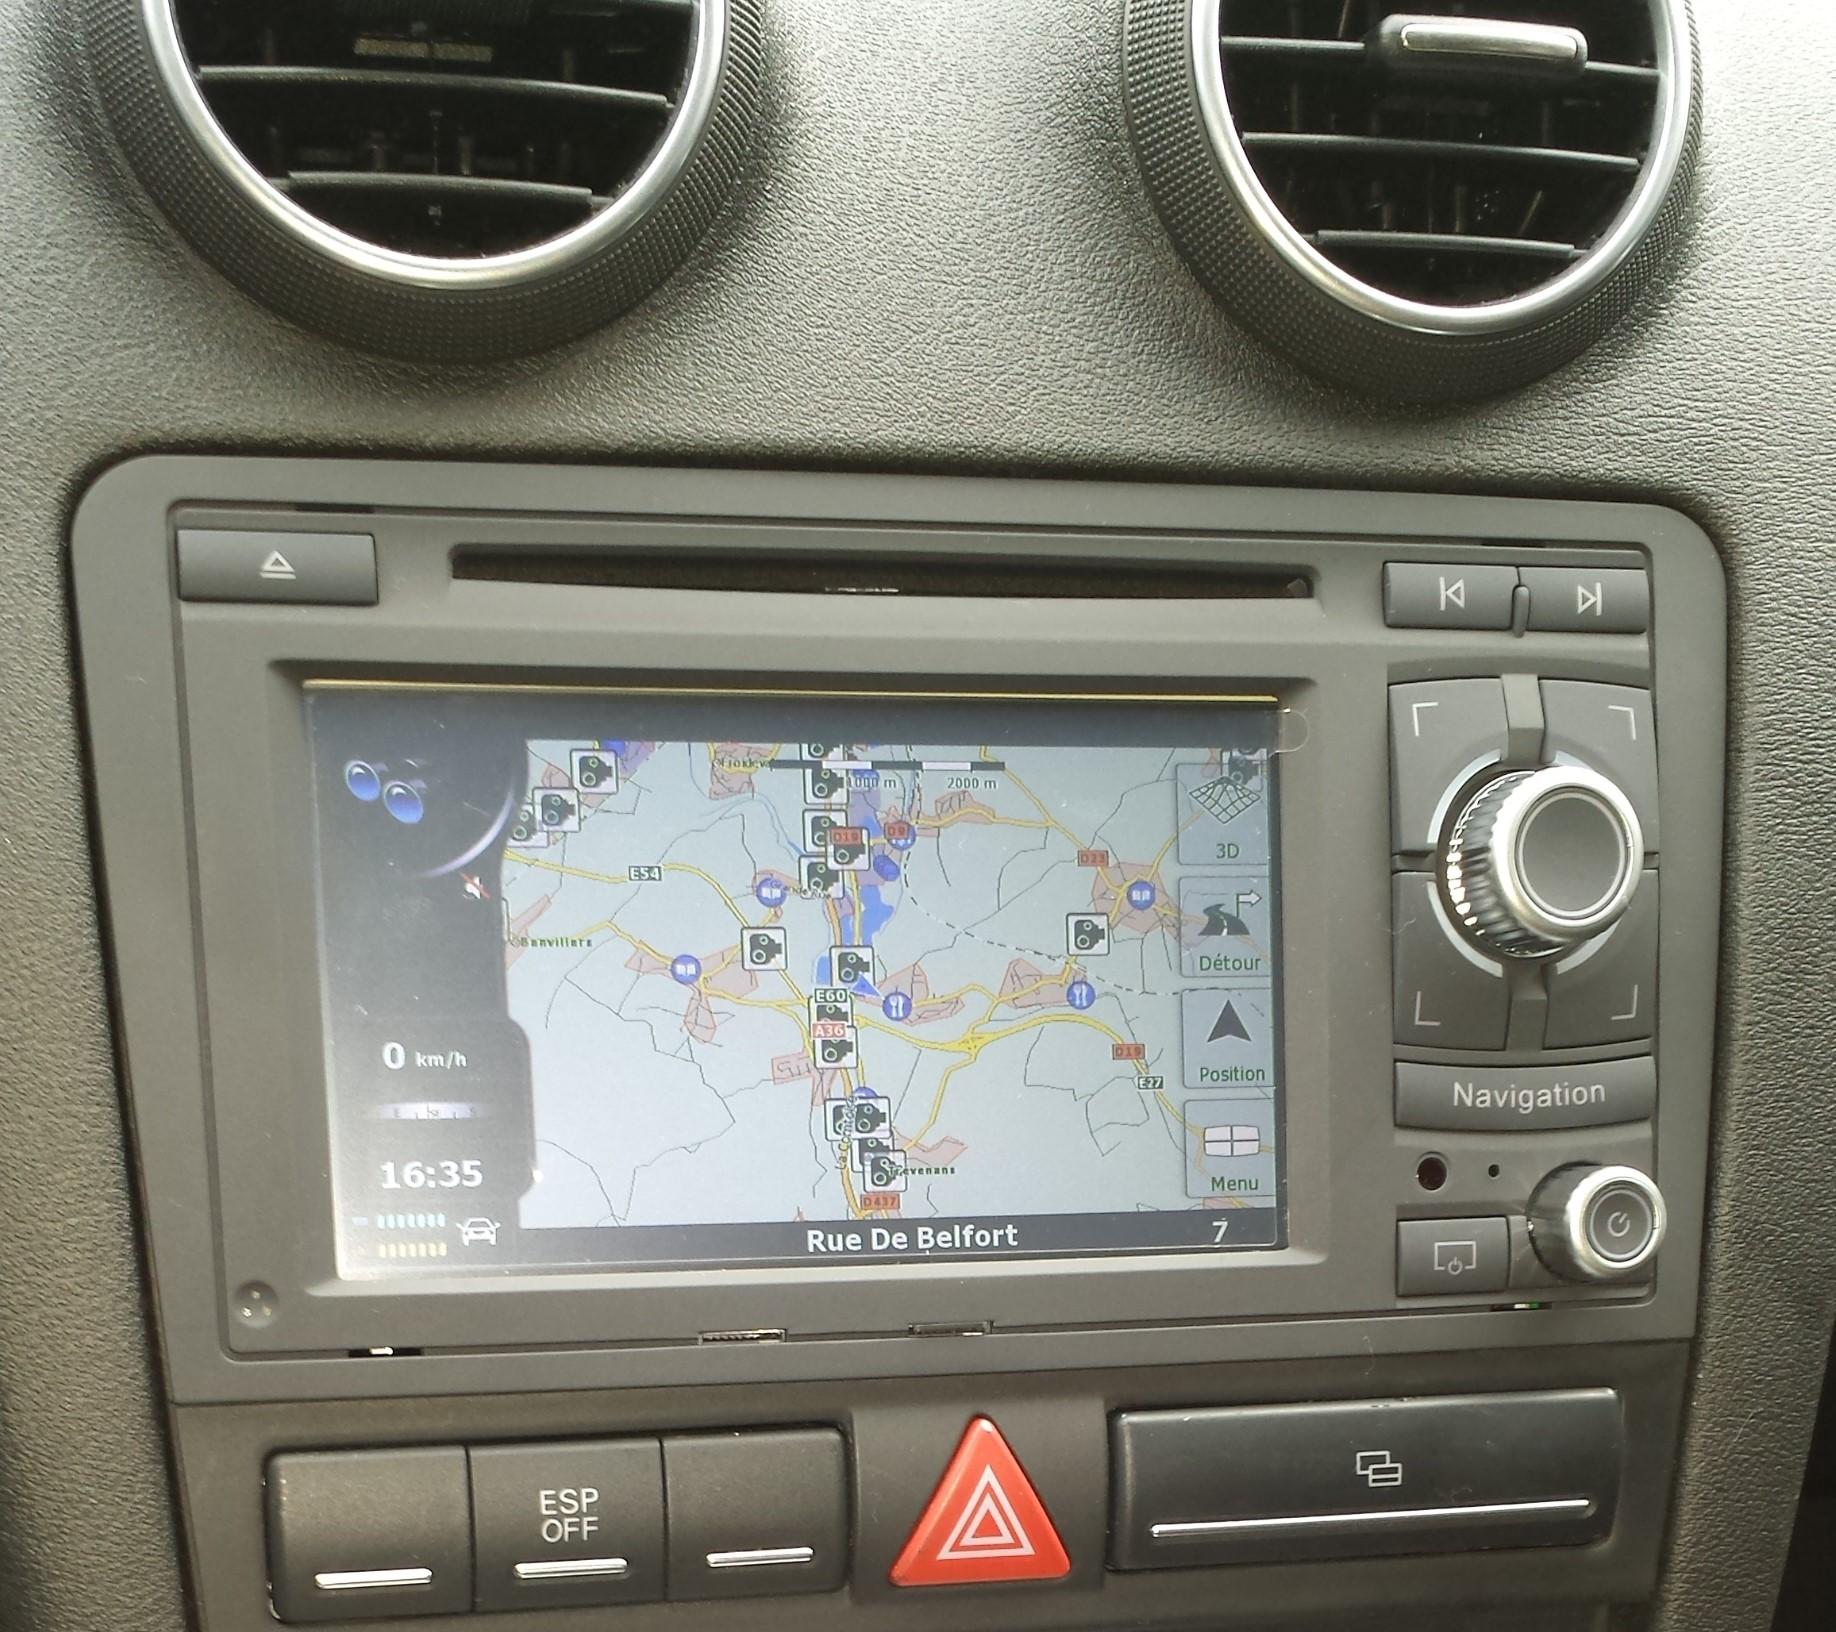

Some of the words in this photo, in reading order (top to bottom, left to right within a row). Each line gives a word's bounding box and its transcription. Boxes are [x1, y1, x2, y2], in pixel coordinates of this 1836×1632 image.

[883, 779, 897, 789] m
[947, 777, 979, 789] 2000
[984, 779, 997, 789] m
[1216, 843, 1240, 859] 3D
[629, 867, 662, 880] E54
[1199, 953, 1262, 971] Détour
[815, 989, 846, 1002] E60
[815, 1024, 845, 1037] A36
[382, 1042, 405, 1070] 0
[415, 1051, 468, 1070] km/h
[1115, 1046, 1142, 1057] D19
[1200, 1066, 1266, 1082] Position
[1139, 1077, 1162, 1089] E27
[1453, 1081, 1606, 1114] Navigation
[379, 1160, 483, 1189] 16:35
[1211, 1176, 1259, 1191] Menu
[807, 1229, 862, 1253] Rue
[871, 1228, 909, 1250] De
[917, 1224, 1019, 1250] Belfort
[1212, 1221, 1229, 1243] 7
[540, 1487, 600, 1516] ESP
[540, 1517, 599, 1544] OFF
